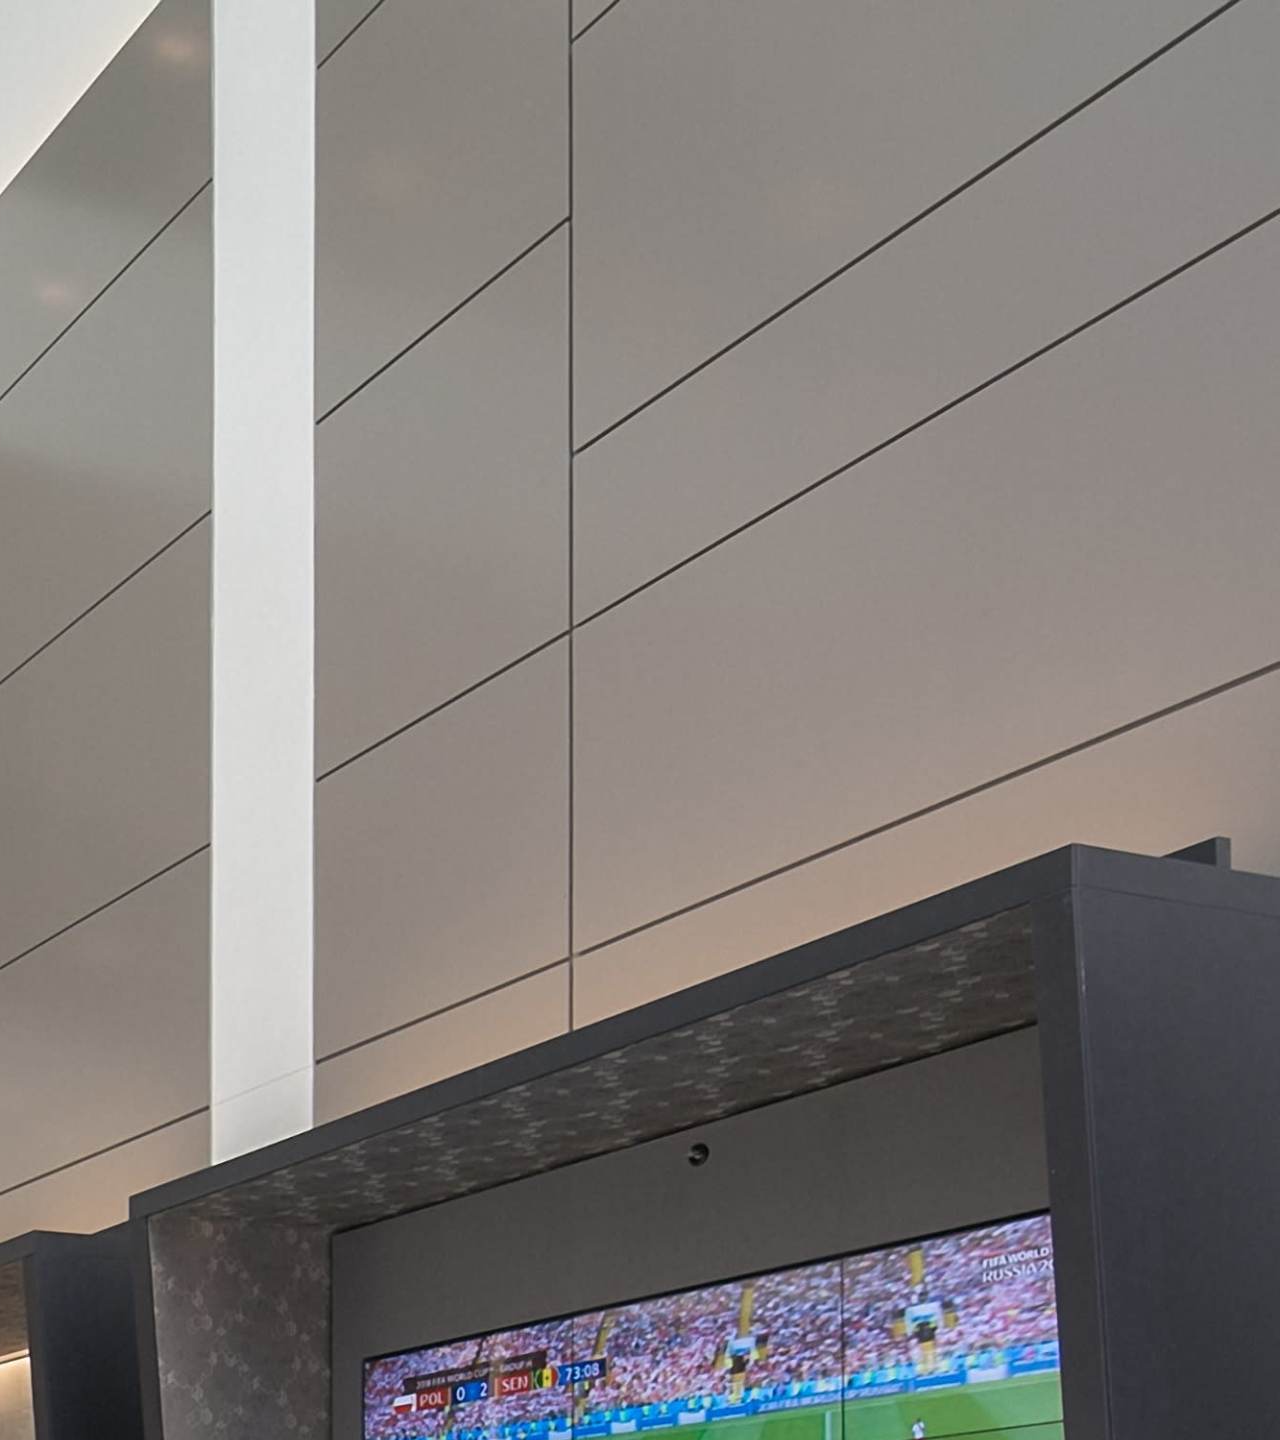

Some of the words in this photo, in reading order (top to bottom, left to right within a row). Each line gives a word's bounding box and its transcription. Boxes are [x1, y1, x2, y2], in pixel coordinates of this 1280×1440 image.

[1007, 1247, 1050, 1264] WORLD
[982, 1263, 1037, 1283] RUSSIA
[564, 1362, 600, 1382] 73:08
[479, 1382, 488, 1397] 2
[501, 1375, 529, 1393] SEN
[418, 1391, 444, 1407] POL
[456, 1386, 466, 1400] 0
